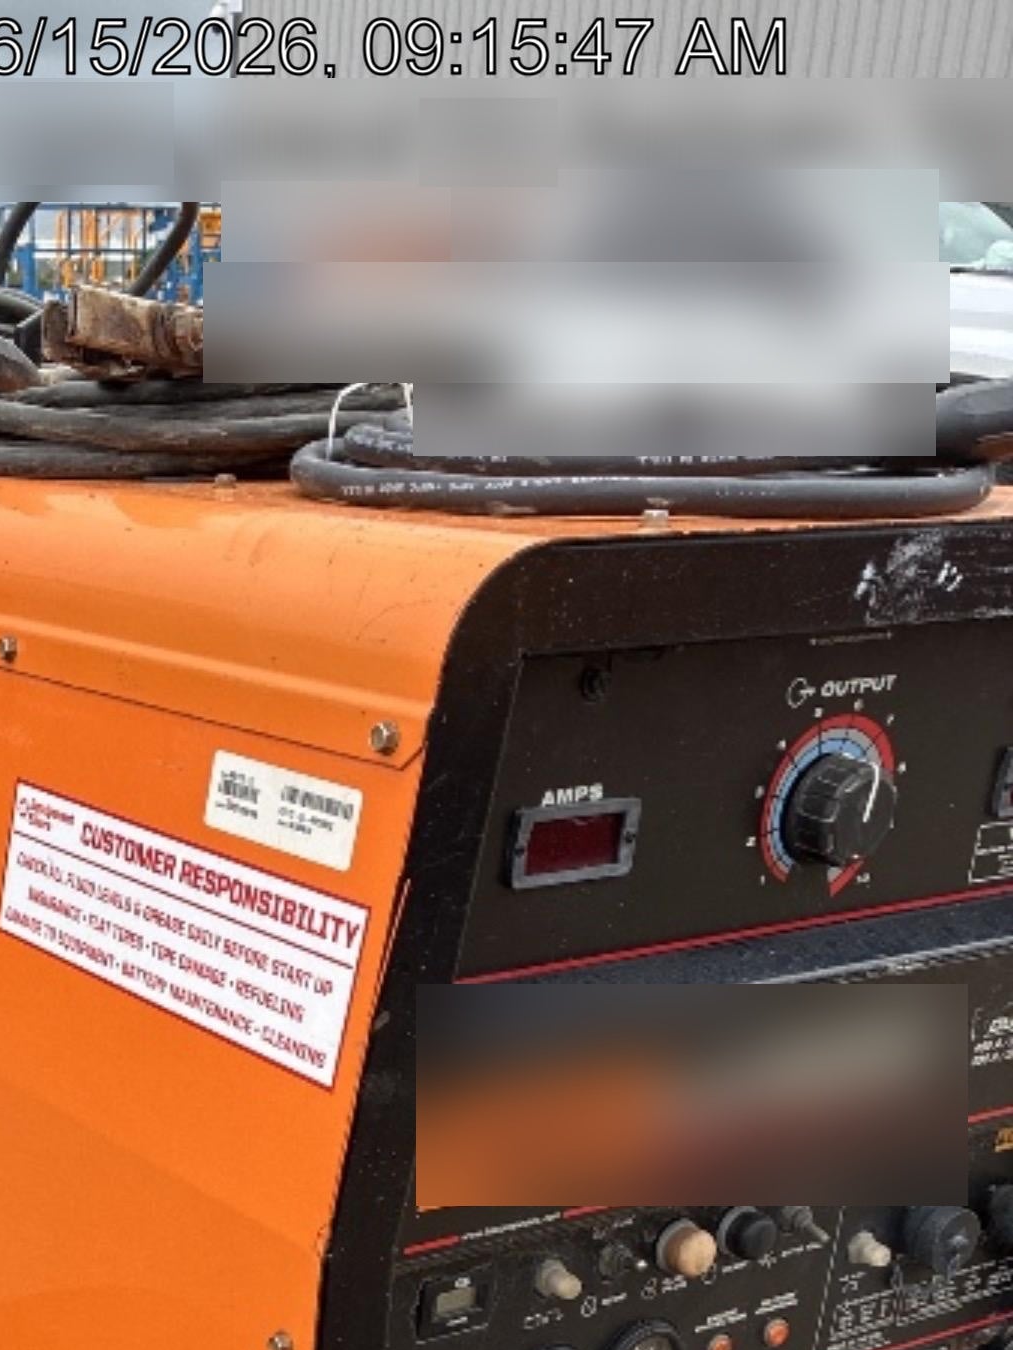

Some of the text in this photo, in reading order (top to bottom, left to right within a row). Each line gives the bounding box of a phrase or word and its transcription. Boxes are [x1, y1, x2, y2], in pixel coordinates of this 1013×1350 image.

[821, 674, 897, 698] OUTPUT
[541, 782, 604, 808] AMPS
[80, 821, 361, 950] CUSTOMER RESPONSIBILITY
[271, 959, 313, 992] START
[313, 977, 334, 998] UP
